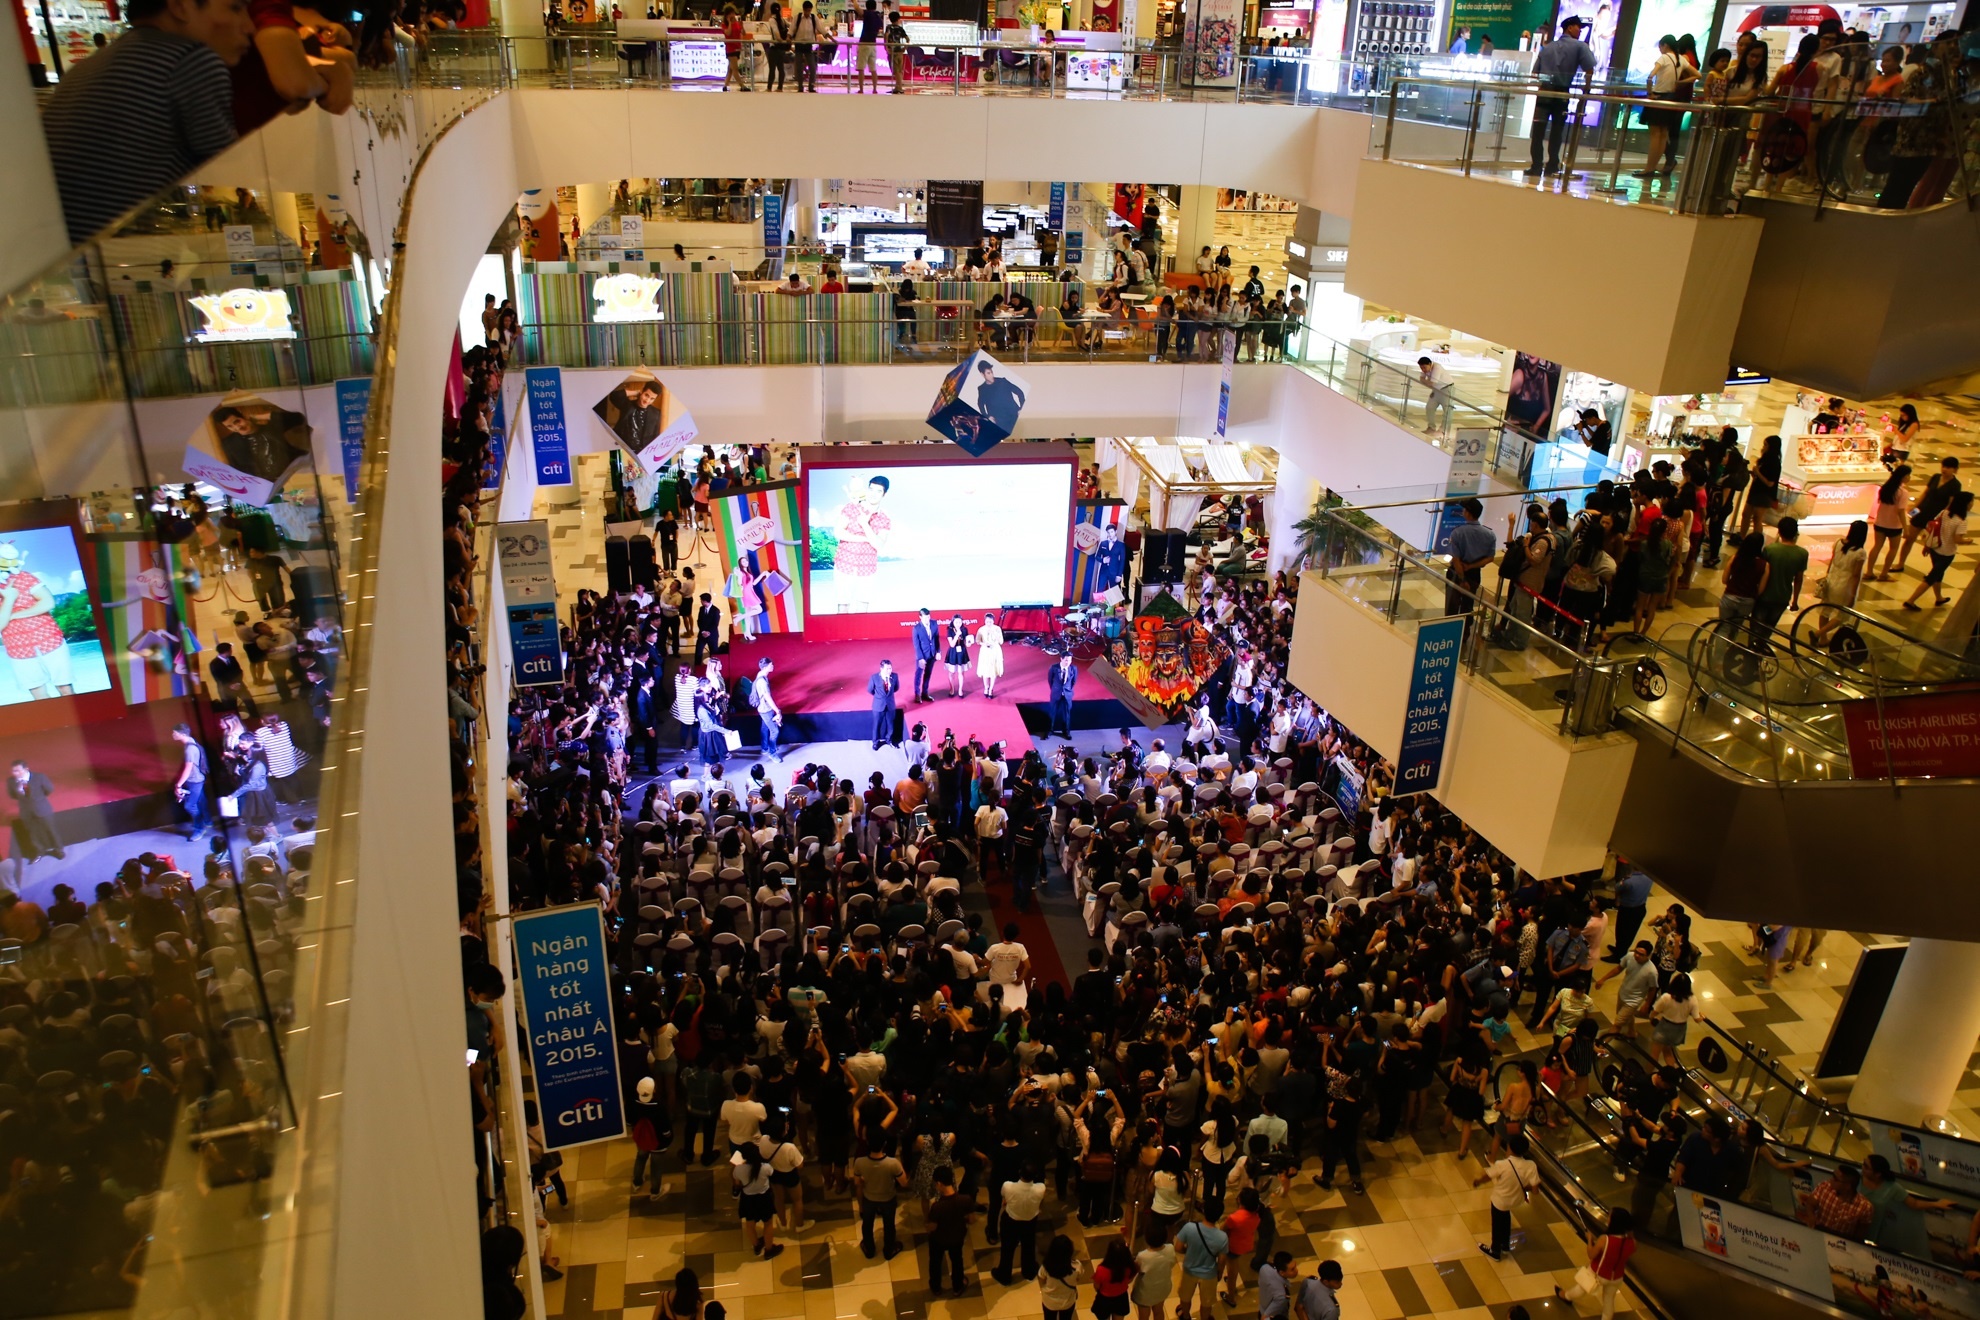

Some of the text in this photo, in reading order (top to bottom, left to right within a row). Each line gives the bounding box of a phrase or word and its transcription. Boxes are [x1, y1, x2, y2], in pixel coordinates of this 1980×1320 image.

[543, 464, 563, 475] citi
[1817, 490, 1859, 499] BOURJOIS
[1423, 639, 1454, 654] Ngân
[523, 658, 552, 674] citi
[1421, 656, 1450, 669] hàng
[1425, 671, 1442, 685] tốt
[1418, 687, 1444, 702] nhất
[1408, 701, 1448, 719] châu Á
[1409, 719, 1441, 734] 2015.
[1865, 713, 1977, 732] TURKISH AIRLINES
[1907, 734, 1930, 751] NỘI
[1932, 732, 1951, 747] VÀ
[1952, 734, 1972, 746] TP.
[1404, 763, 1430, 780] citi
[532, 934, 588, 956] Ngân
[536, 957, 589, 979] hàng
[549, 979, 581, 999] tốt
[545, 1000, 592, 1023] nhất
[535, 1017, 608, 1047] châu Á
[545, 1043, 603, 1066] 2015.
[558, 1102, 603, 1126] citi
